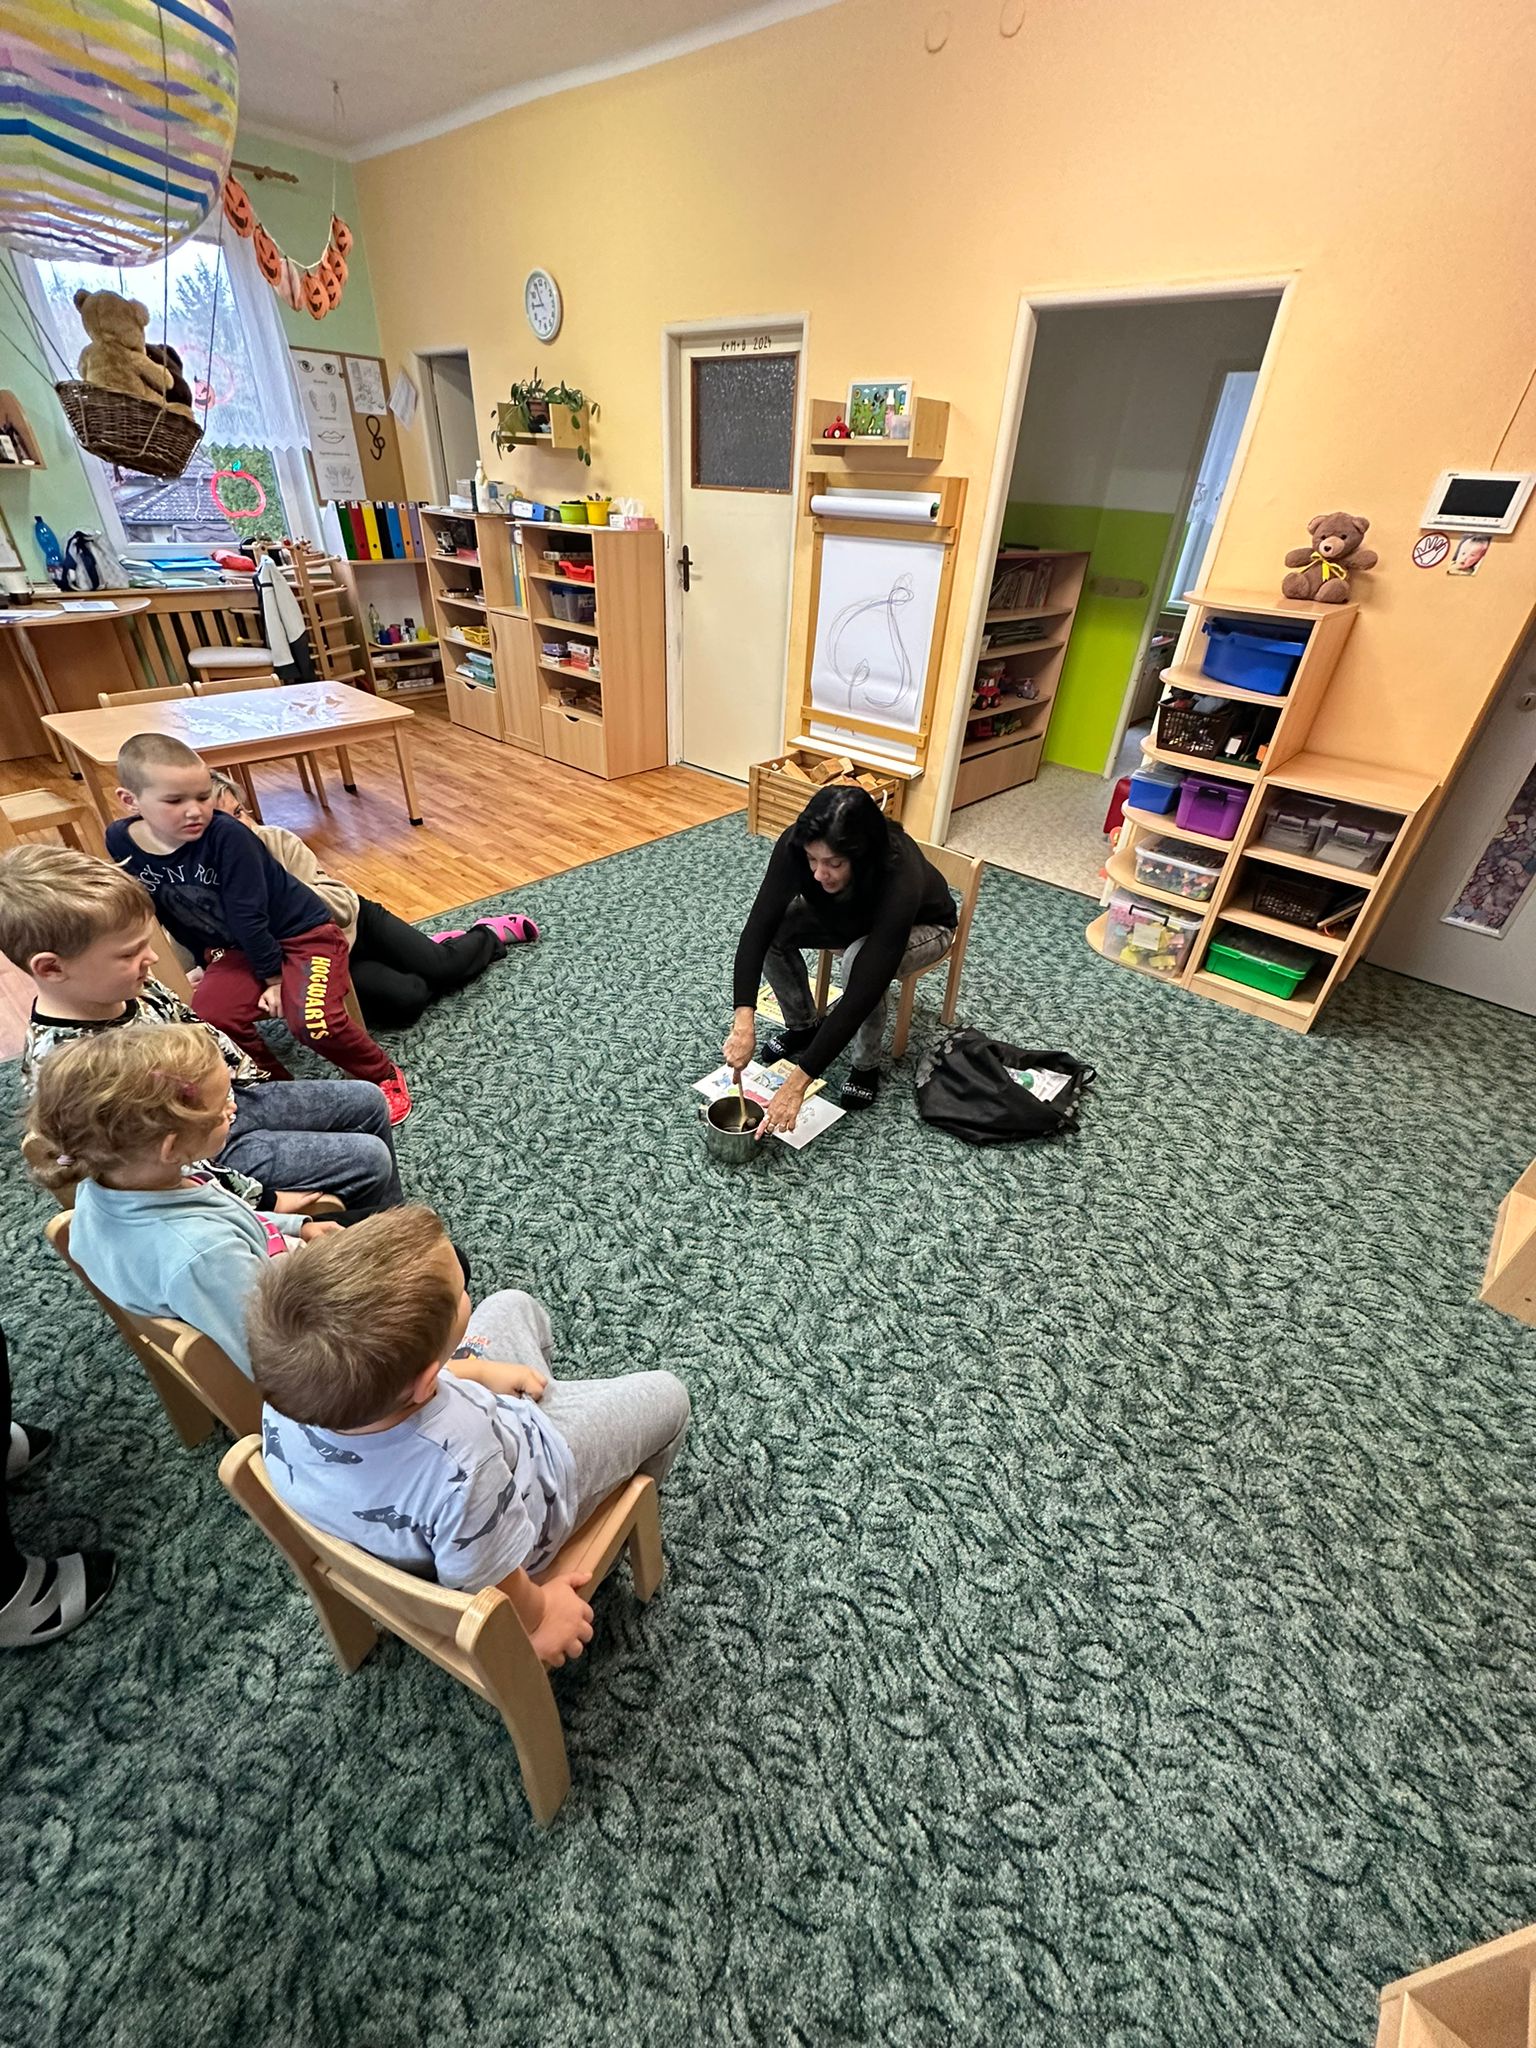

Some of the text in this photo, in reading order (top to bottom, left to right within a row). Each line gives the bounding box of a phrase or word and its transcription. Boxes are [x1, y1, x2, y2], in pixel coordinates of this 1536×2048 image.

[753, 335, 772, 350] 2024
[138, 864, 164, 892] OCK
[194, 863, 221, 886] ROL
[305, 955, 331, 1040] HOGWARTS
